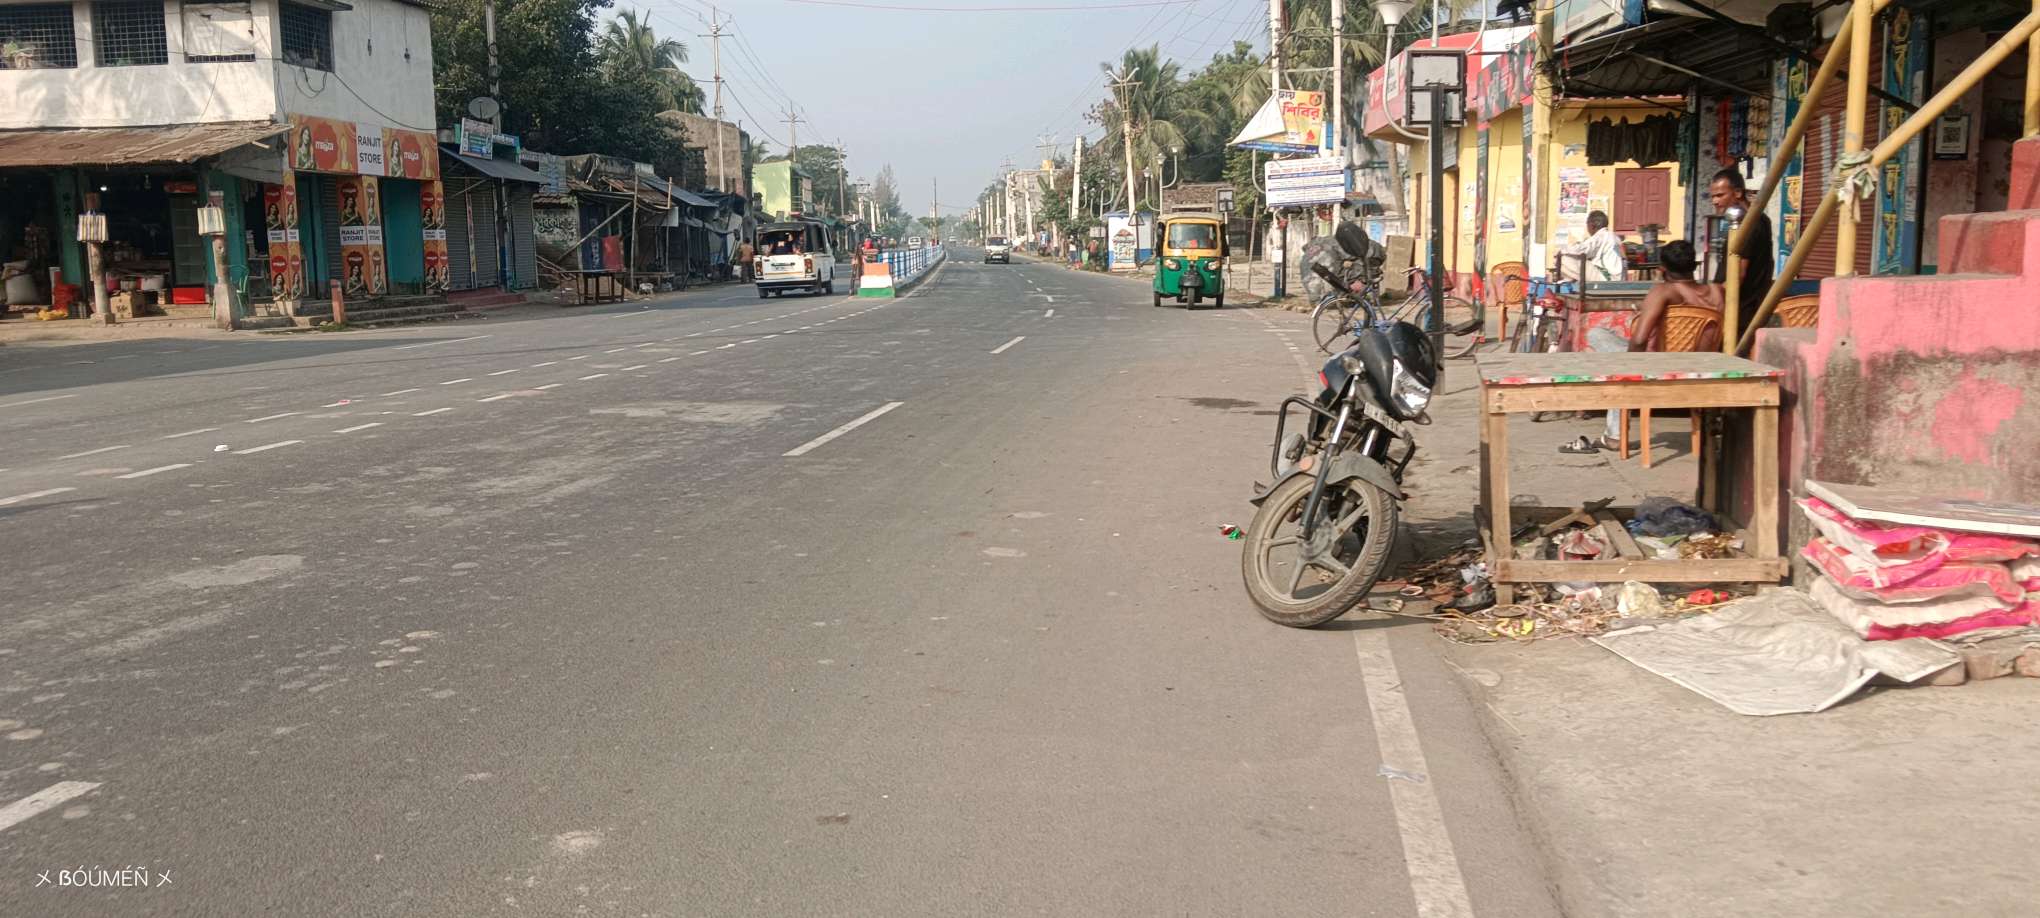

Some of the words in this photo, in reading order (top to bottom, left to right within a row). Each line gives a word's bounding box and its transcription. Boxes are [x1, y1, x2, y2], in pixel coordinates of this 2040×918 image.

[1282, 102, 1320, 120] শিবির
[357, 135, 381, 148] RANJIT
[359, 152, 383, 164] STORE
